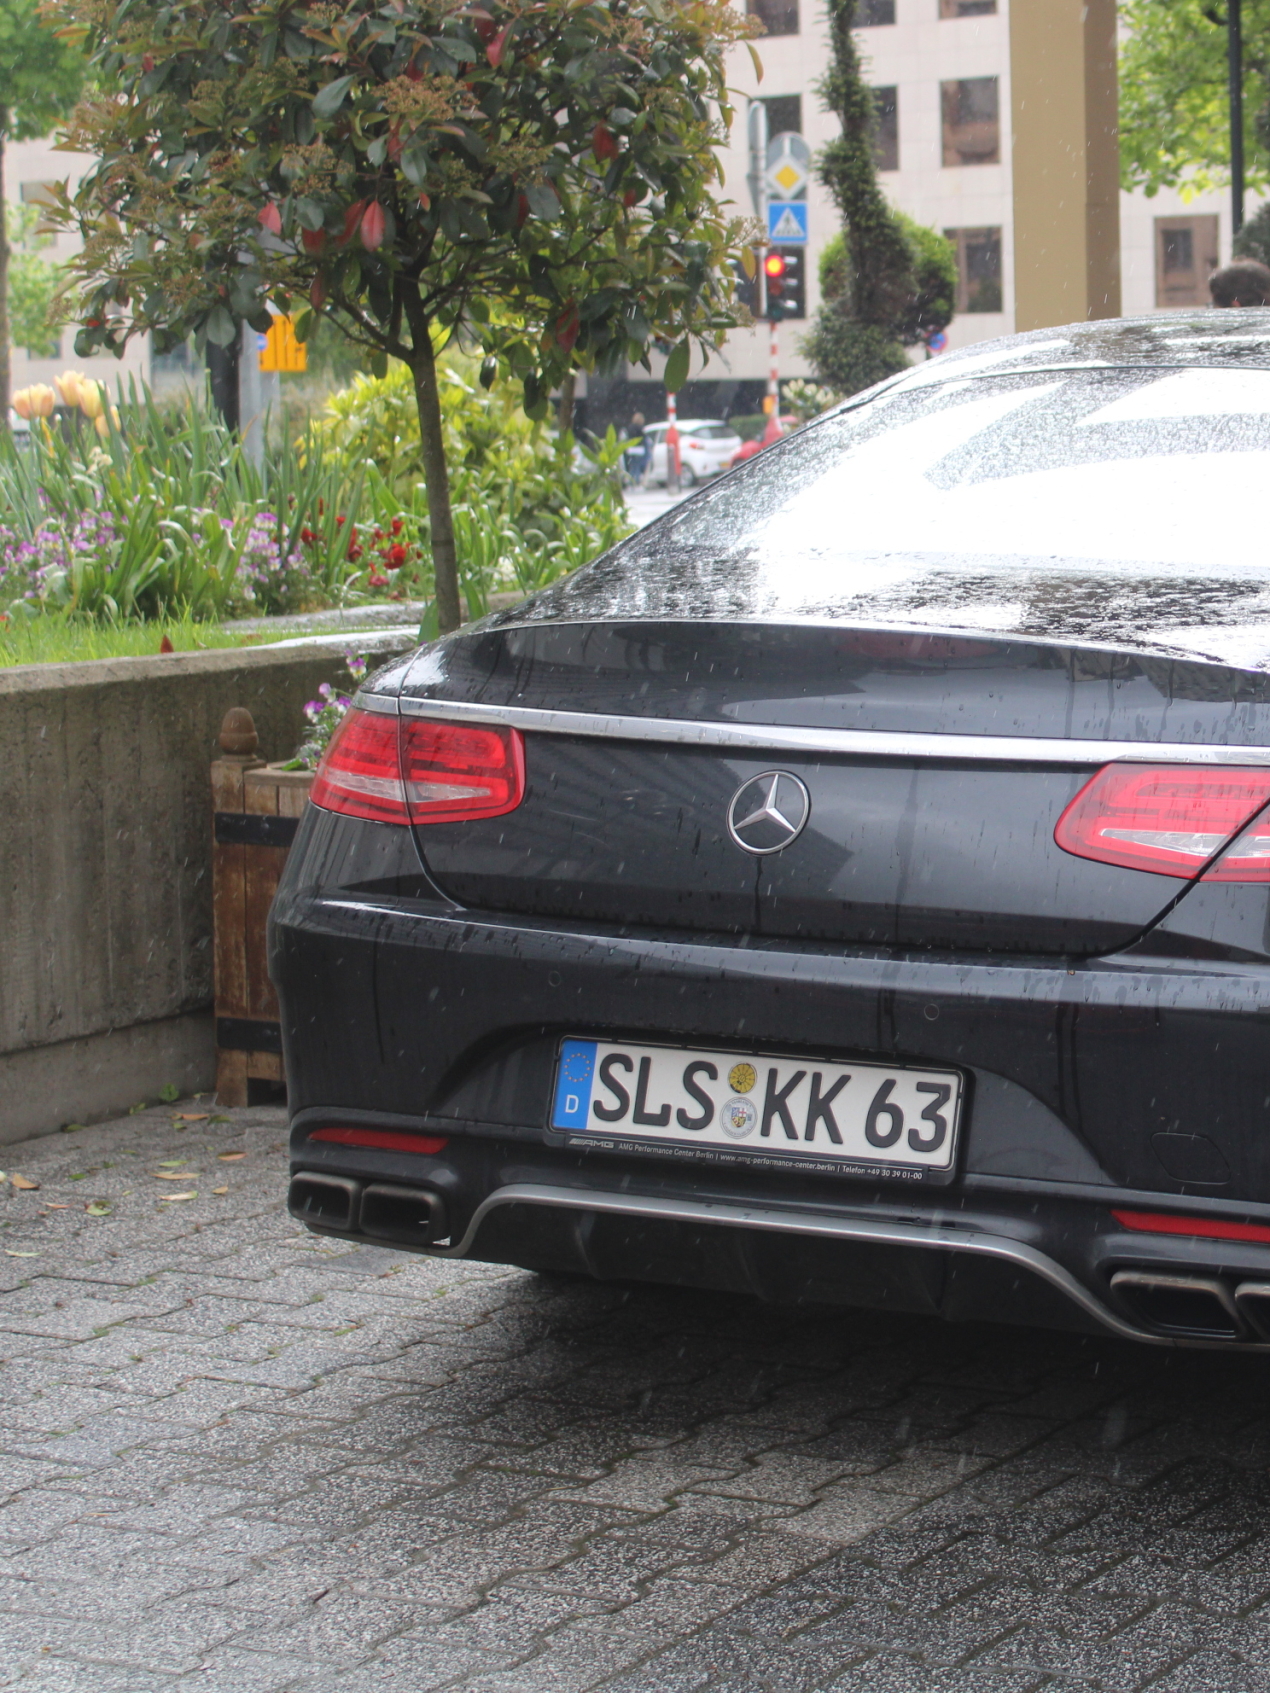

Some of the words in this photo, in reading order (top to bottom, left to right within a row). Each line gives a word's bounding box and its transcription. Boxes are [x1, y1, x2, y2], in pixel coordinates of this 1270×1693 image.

[564, 1094, 579, 1113] D
[593, 1053, 718, 1130] SLS
[760, 1068, 852, 1144] KK
[864, 1079, 952, 1153] 63
[618, 1142, 633, 1151] AMG
[634, 1145, 673, 1156] Performance
[673, 1148, 695, 1158] Center
[695, 1150, 714, 1159] Berlin
[720, 1154, 835, 1172] www.amg-performance-center.berlin
[842, 1165, 866, 1175] Telefon
[867, 1168, 880, 1176] +49
[881, 1169, 891, 1178] 30
[892, 1170, 901, 1178] 39
[902, 1171, 923, 1180] 01-00
